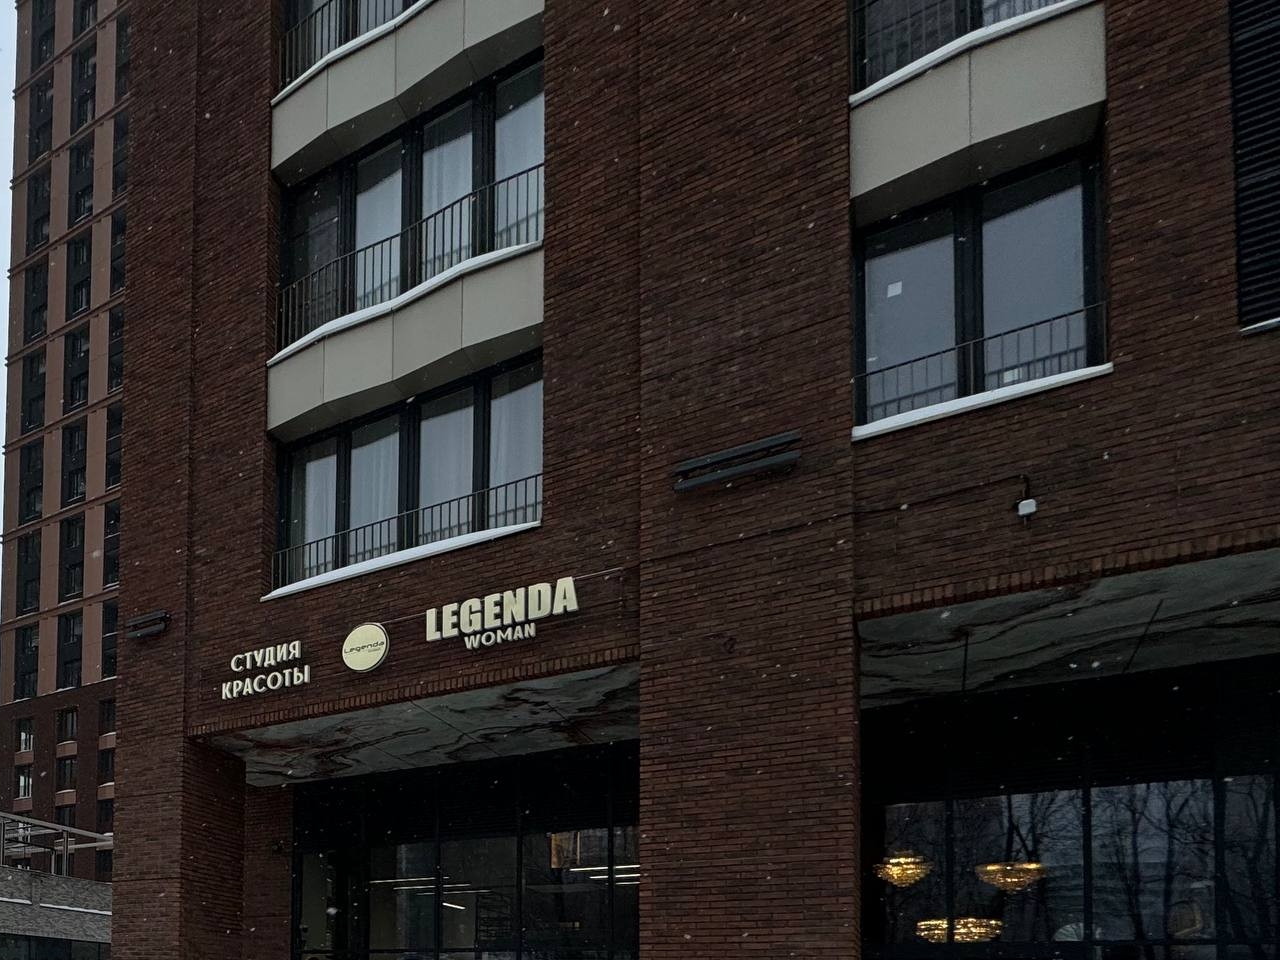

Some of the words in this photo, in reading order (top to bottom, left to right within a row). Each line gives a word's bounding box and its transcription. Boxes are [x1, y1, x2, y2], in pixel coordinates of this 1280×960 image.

[425, 576, 579, 641] LEGENDA
[344, 641, 385, 654] Legenda
[464, 622, 537, 651] WOMAN
[230, 640, 302, 673] СТУДИЯ
[222, 664, 311, 700] КРАСОТЫ
